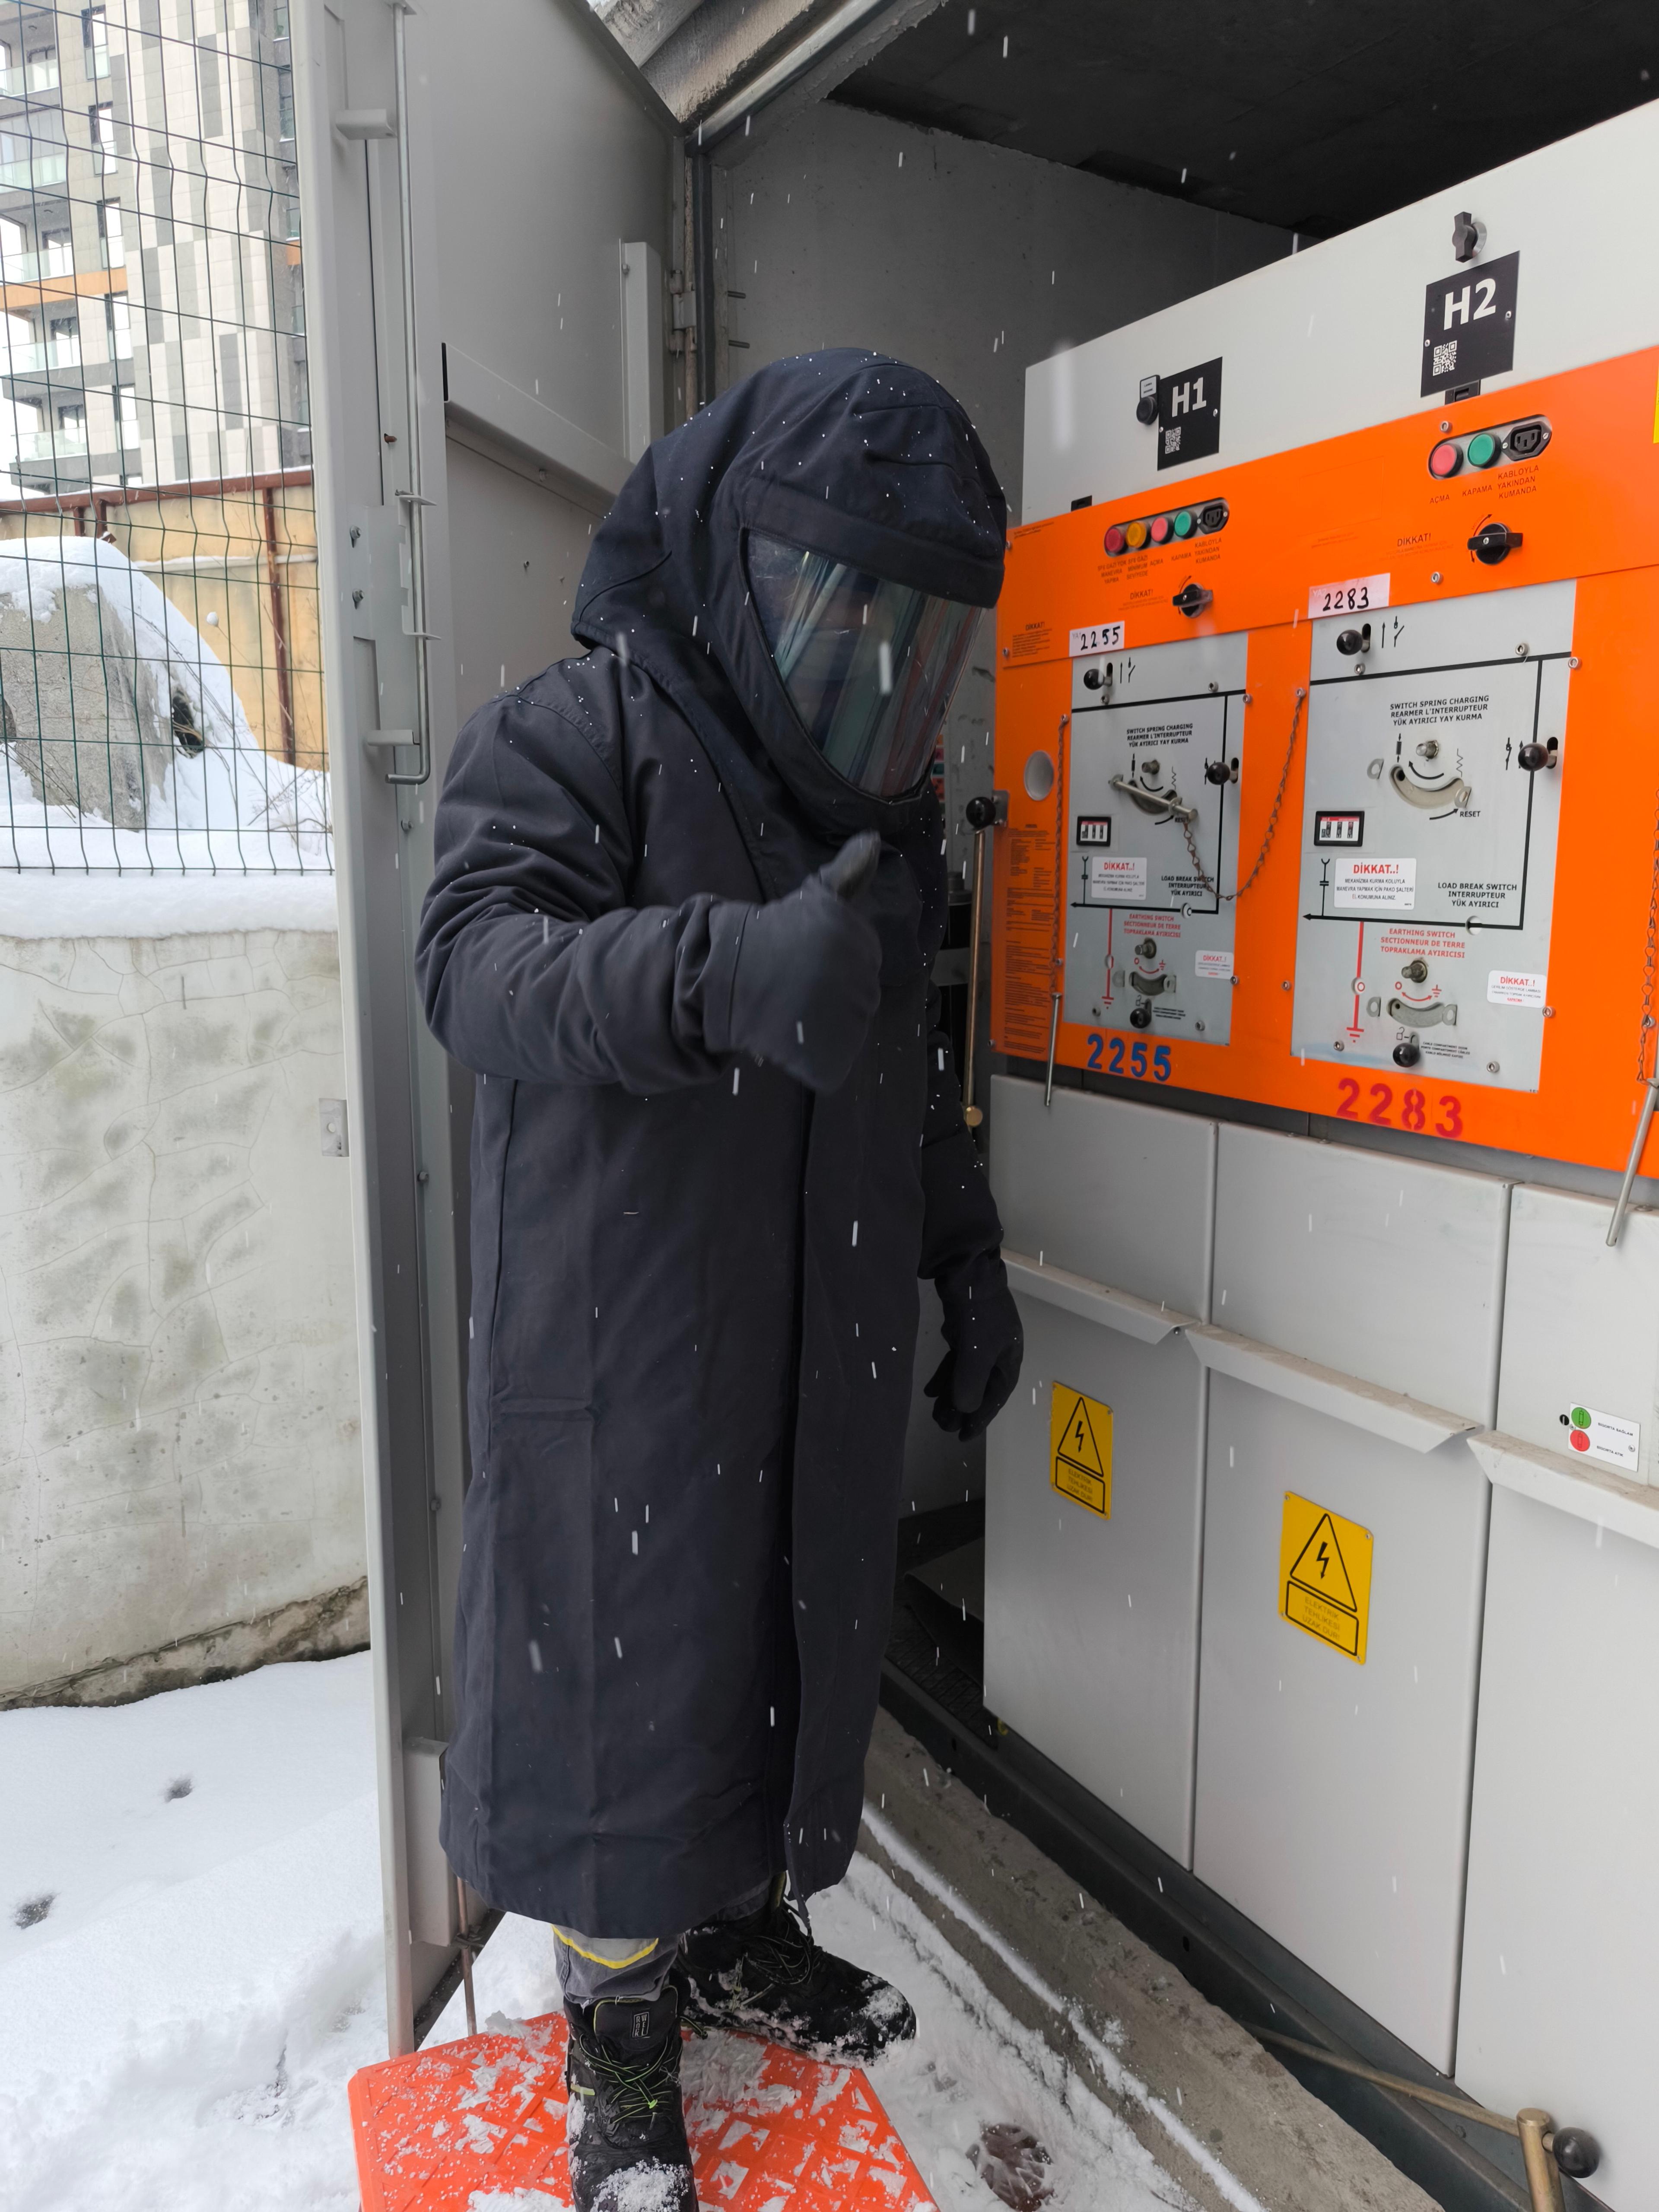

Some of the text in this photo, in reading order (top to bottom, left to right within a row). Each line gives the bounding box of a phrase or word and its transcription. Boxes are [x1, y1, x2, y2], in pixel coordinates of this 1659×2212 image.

[1443, 278, 1497, 330] H2
[1172, 377, 1206, 417] H1
[1498, 465, 1539, 480] KABLOYLA
[1497, 476, 1535, 489] YAKINDAN
[1462, 485, 1492, 497] KAPAMA
[1499, 485, 1537, 499] KUMANDA
[1430, 494, 1450, 504] AÇMA
[1195, 537, 1222, 548] KABLOYLA
[1171, 552, 1192, 561] KAPAMA
[1195, 546, 1220, 556] YAKINDAN
[1195, 554, 1220, 564] KUMANDA
[1322, 587, 1369, 612] 2283
[1081, 626, 1120, 651] 2255
[1390, 695, 1489, 710] SWITCH SPRING CHARGING
[1391, 704, 1487, 718] REARMER L'INTERRUPTEUR
[1393, 717, 1407, 726] YÜK
[1150, 730, 1192, 739] L'INTERRUPTEUR
[1381, 937, 1429, 946] SECTIONNEUR
[1381, 946, 1465, 958] TOPRAKLAMA AYIRICISI
[1087, 1033, 1171, 1081] 2255
[1336, 1077, 1463, 1138] 2283
[1303, 1614, 1321, 1630] UZAK
